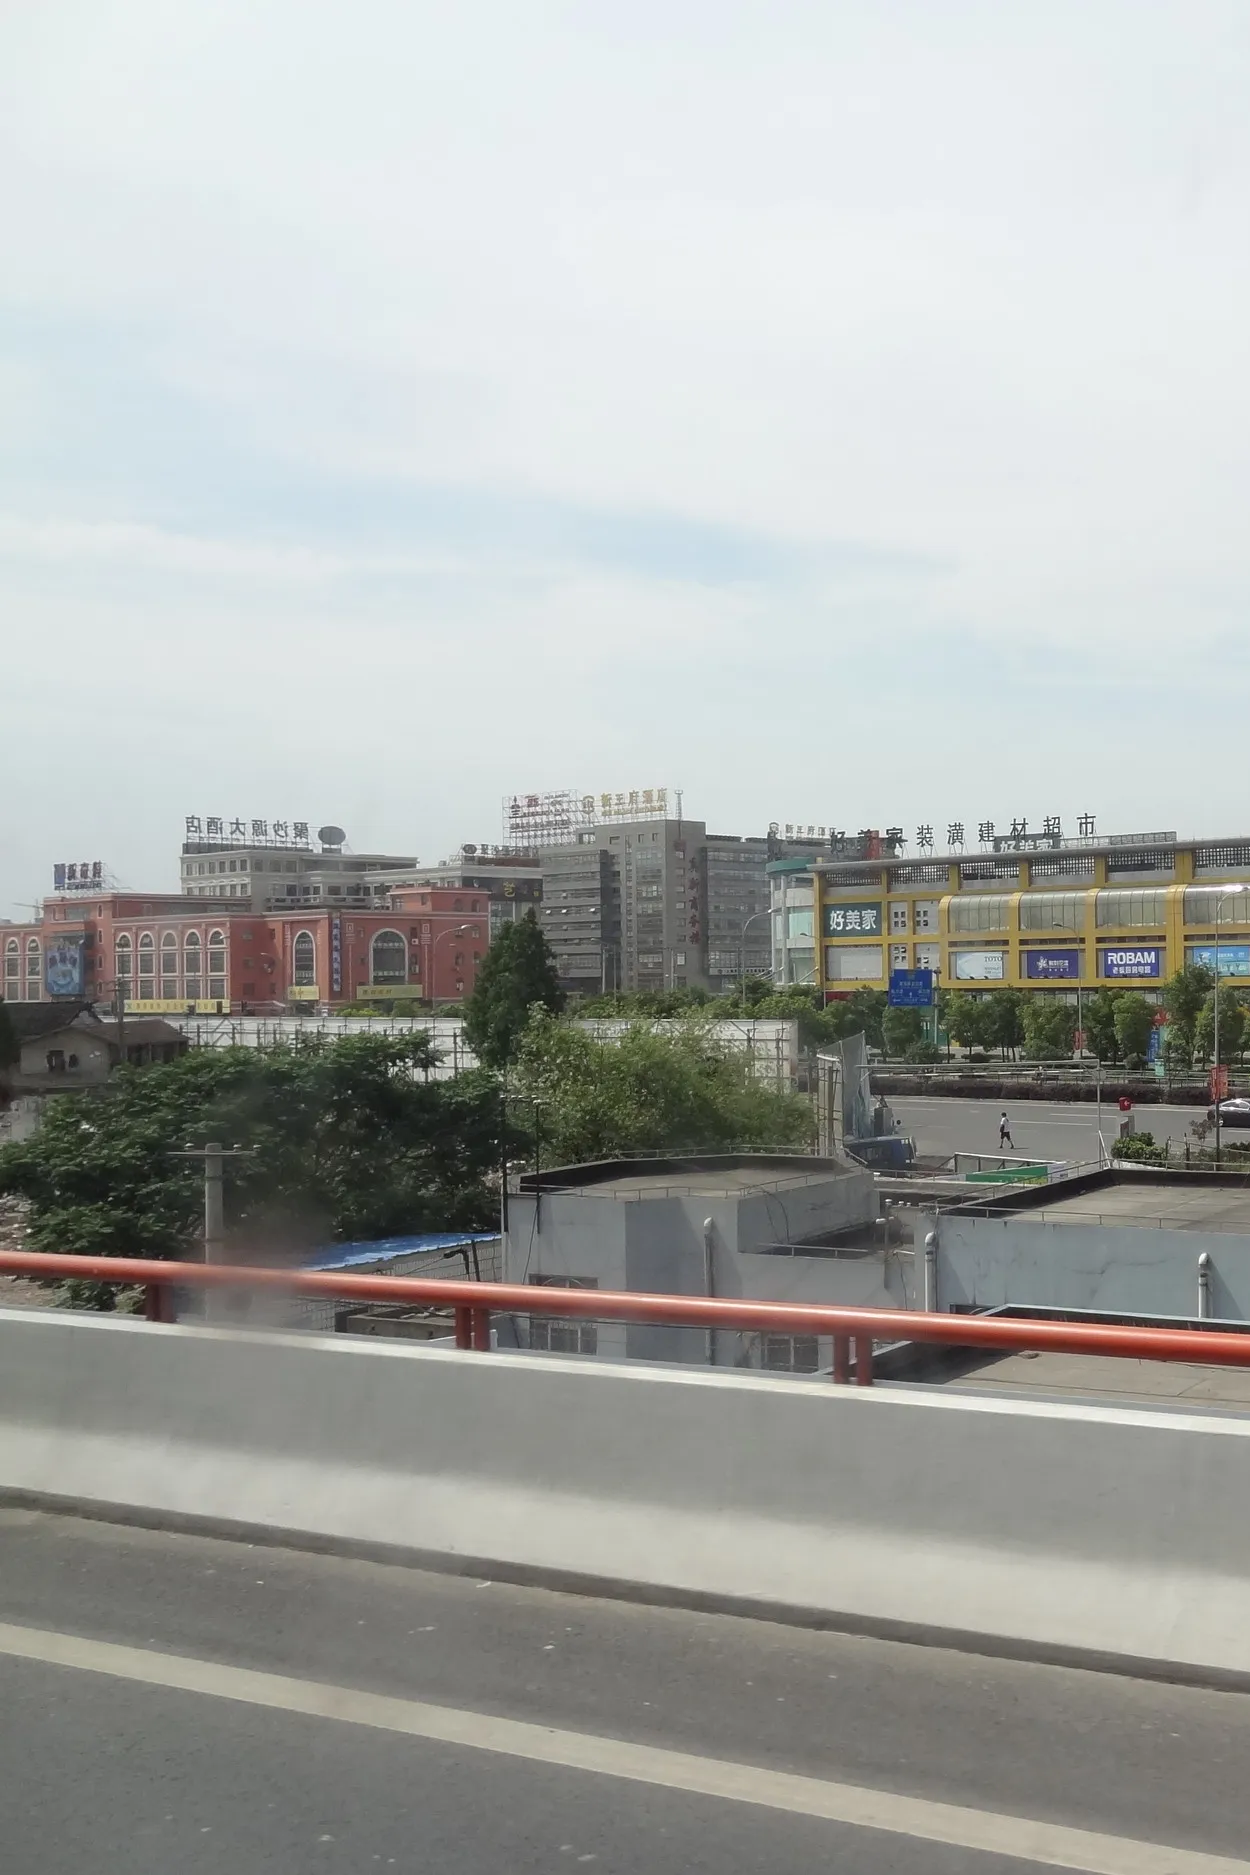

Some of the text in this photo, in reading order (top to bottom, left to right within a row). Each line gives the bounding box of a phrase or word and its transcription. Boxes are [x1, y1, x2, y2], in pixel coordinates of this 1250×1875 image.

[830, 909, 877, 931] 好美家
[1107, 951, 1156, 965] ROBAM
